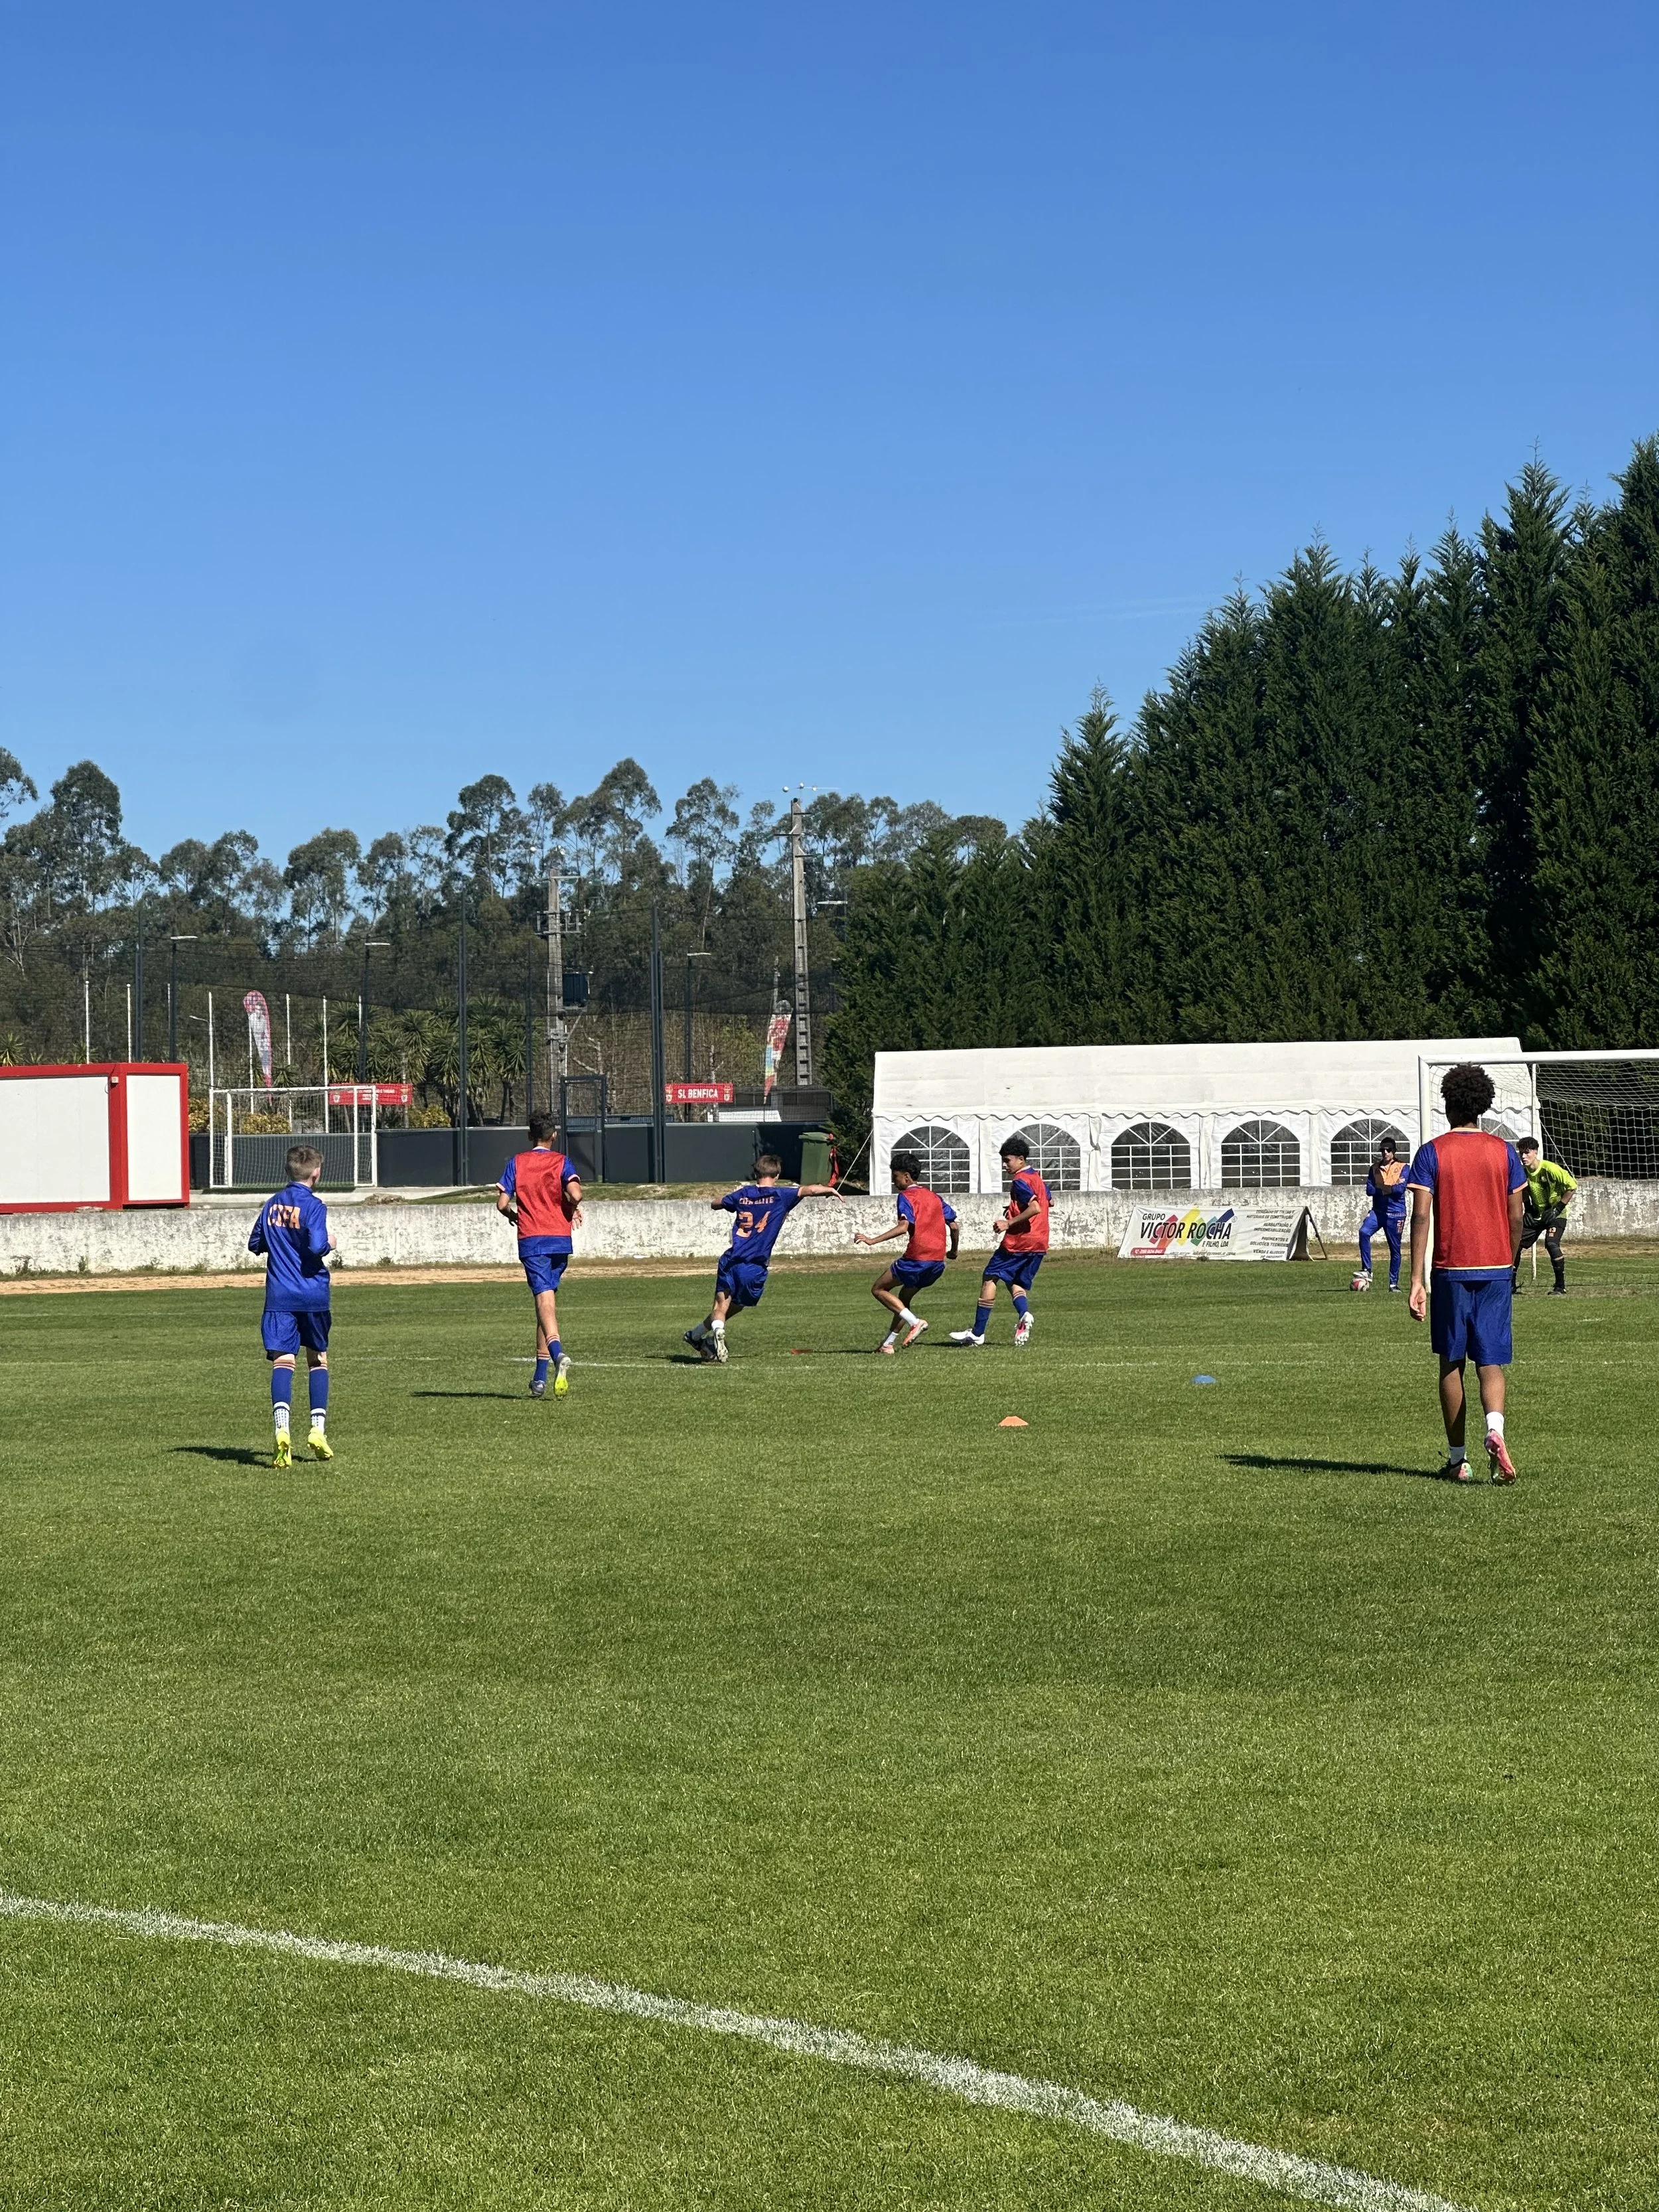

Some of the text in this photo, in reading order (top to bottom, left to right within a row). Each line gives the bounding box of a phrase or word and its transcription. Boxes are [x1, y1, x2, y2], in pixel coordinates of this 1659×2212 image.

[678, 1088, 719, 1099] SL BENFICA
[267, 1204, 301, 1229] CIFA
[736, 1211, 771, 1238] 24
[1140, 1222, 1232, 1240] VICTOR ROCHA
